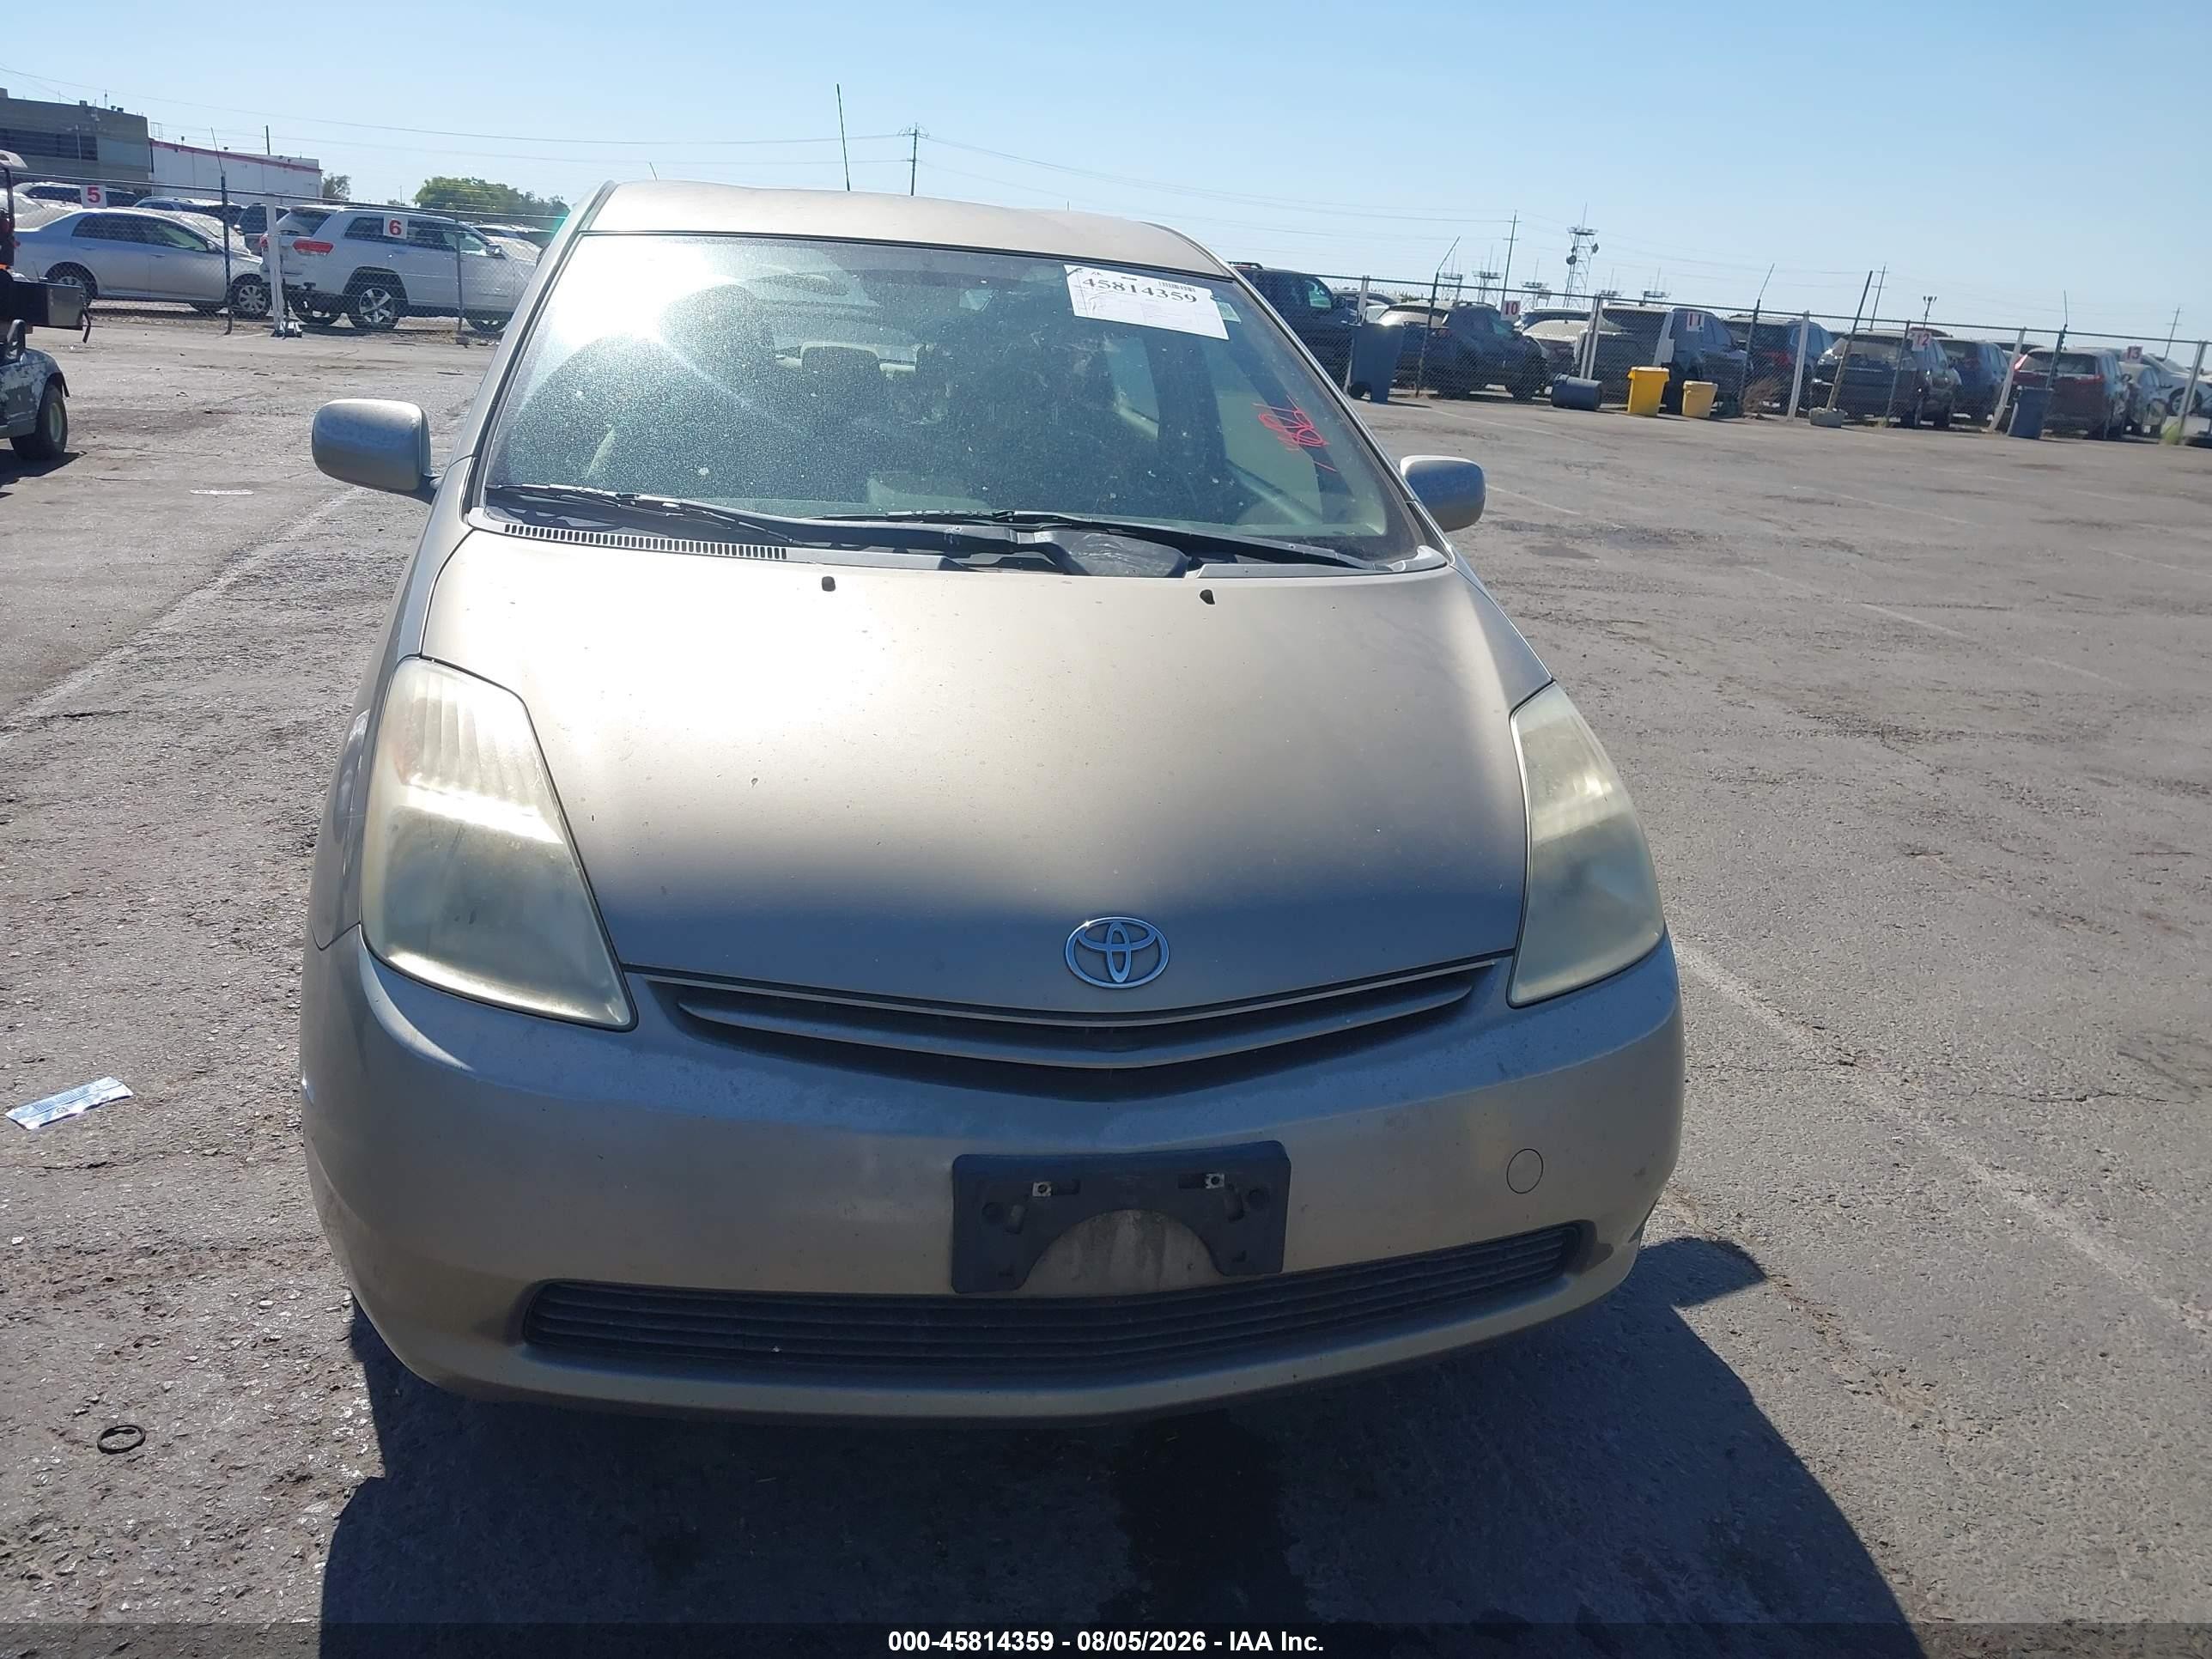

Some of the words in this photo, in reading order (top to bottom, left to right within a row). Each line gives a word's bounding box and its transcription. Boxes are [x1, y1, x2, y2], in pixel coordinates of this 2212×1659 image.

[88, 186, 100, 203] 5
[389, 219, 402, 235] 6
[1082, 277, 1197, 302] 45814359
[1505, 301, 1518, 315] 10
[1688, 313, 1702, 326] 11
[1916, 333, 1929, 347] 12
[2127, 346, 2141, 360] 13
